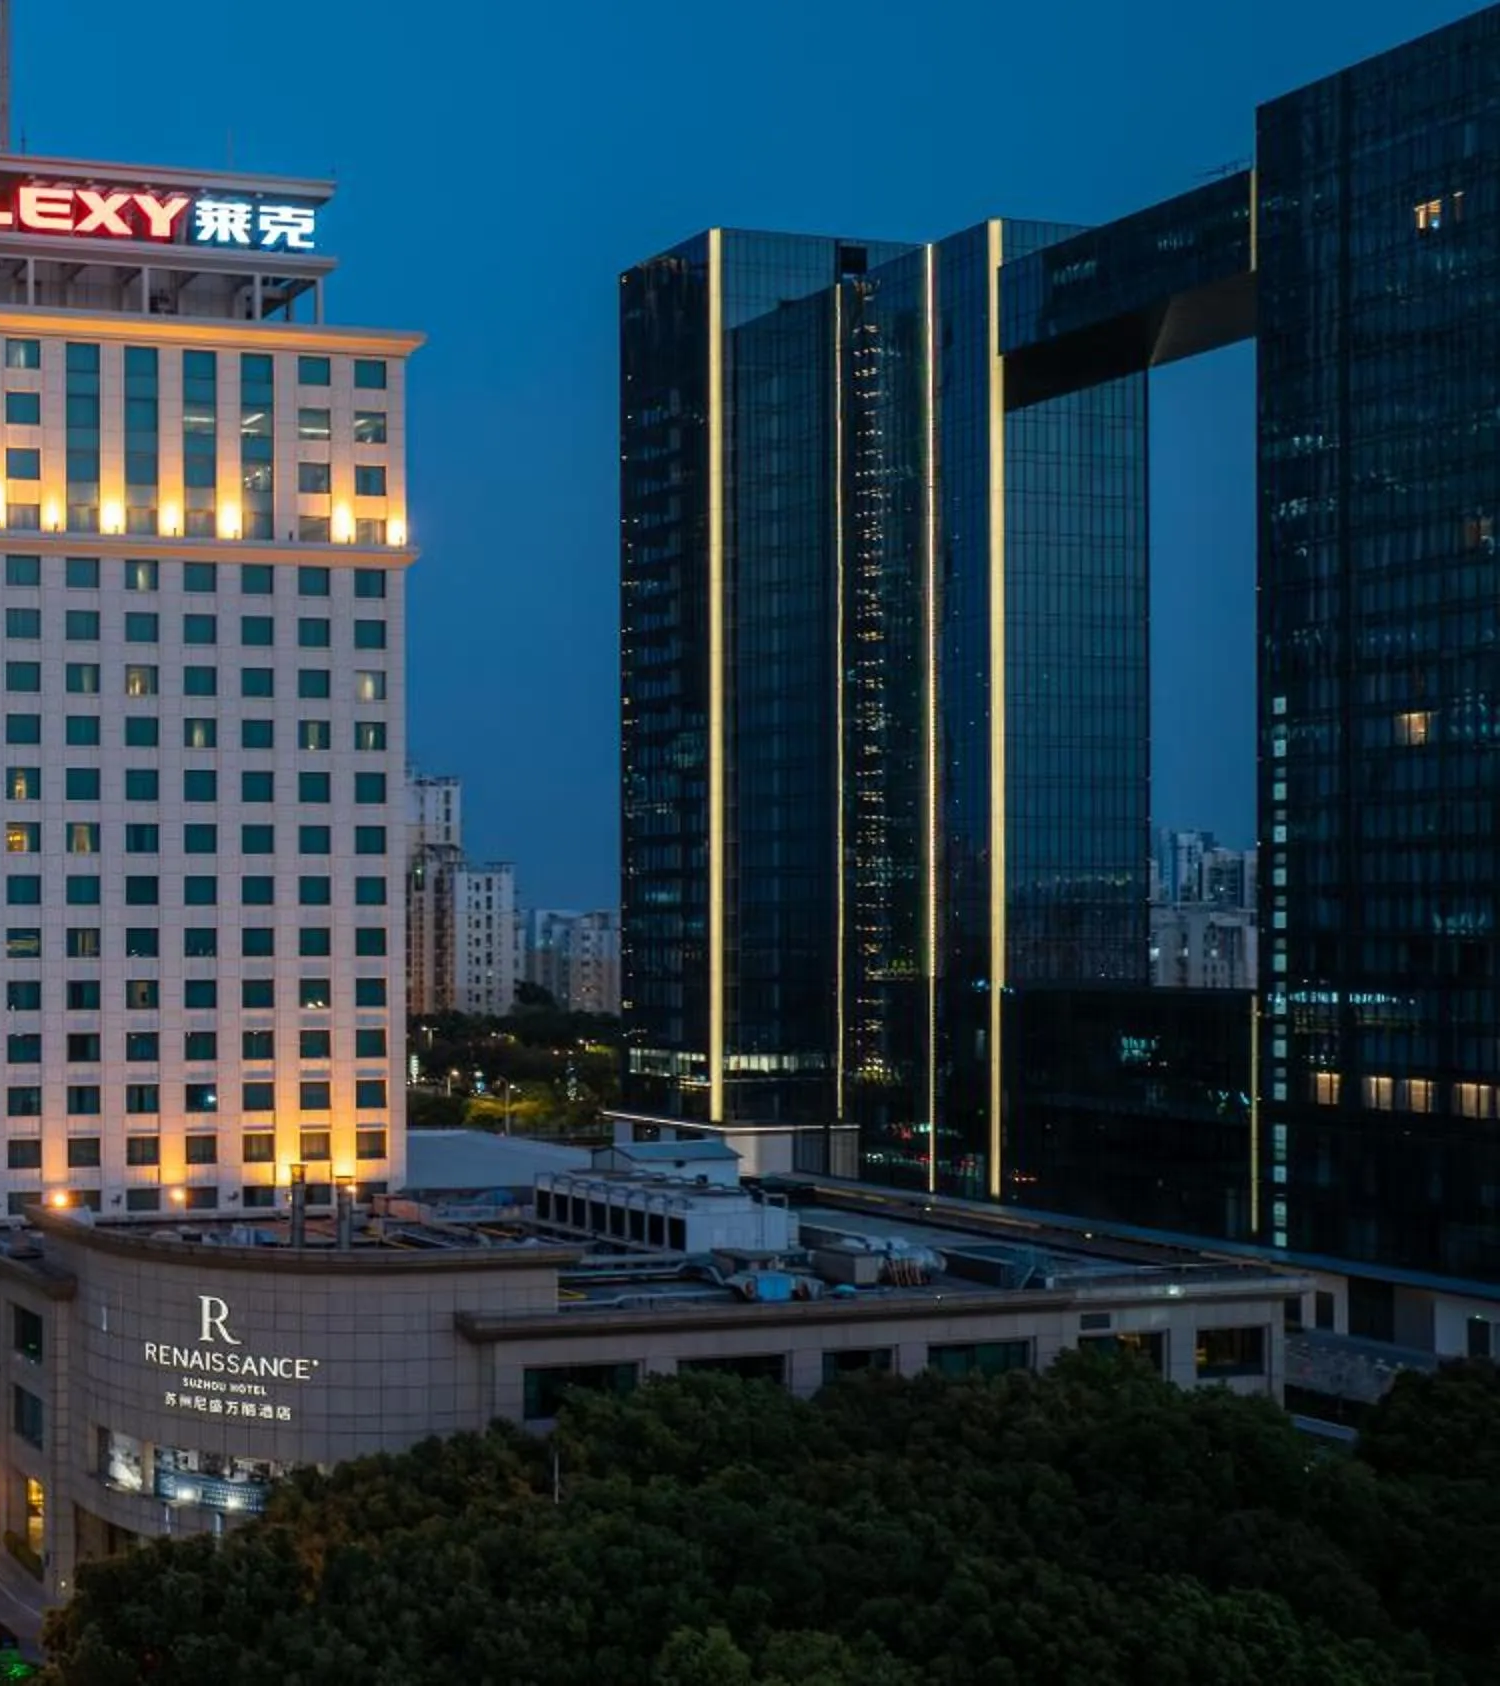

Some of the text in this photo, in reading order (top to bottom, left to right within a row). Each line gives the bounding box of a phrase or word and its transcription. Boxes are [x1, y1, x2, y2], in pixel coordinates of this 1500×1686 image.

[195, 199, 315, 248] 莱克
[198, 1295, 241, 1345] R
[144, 1342, 312, 1380] RENAISSANCE
[182, 1376, 267, 1396] SUZHOU HOTEL
